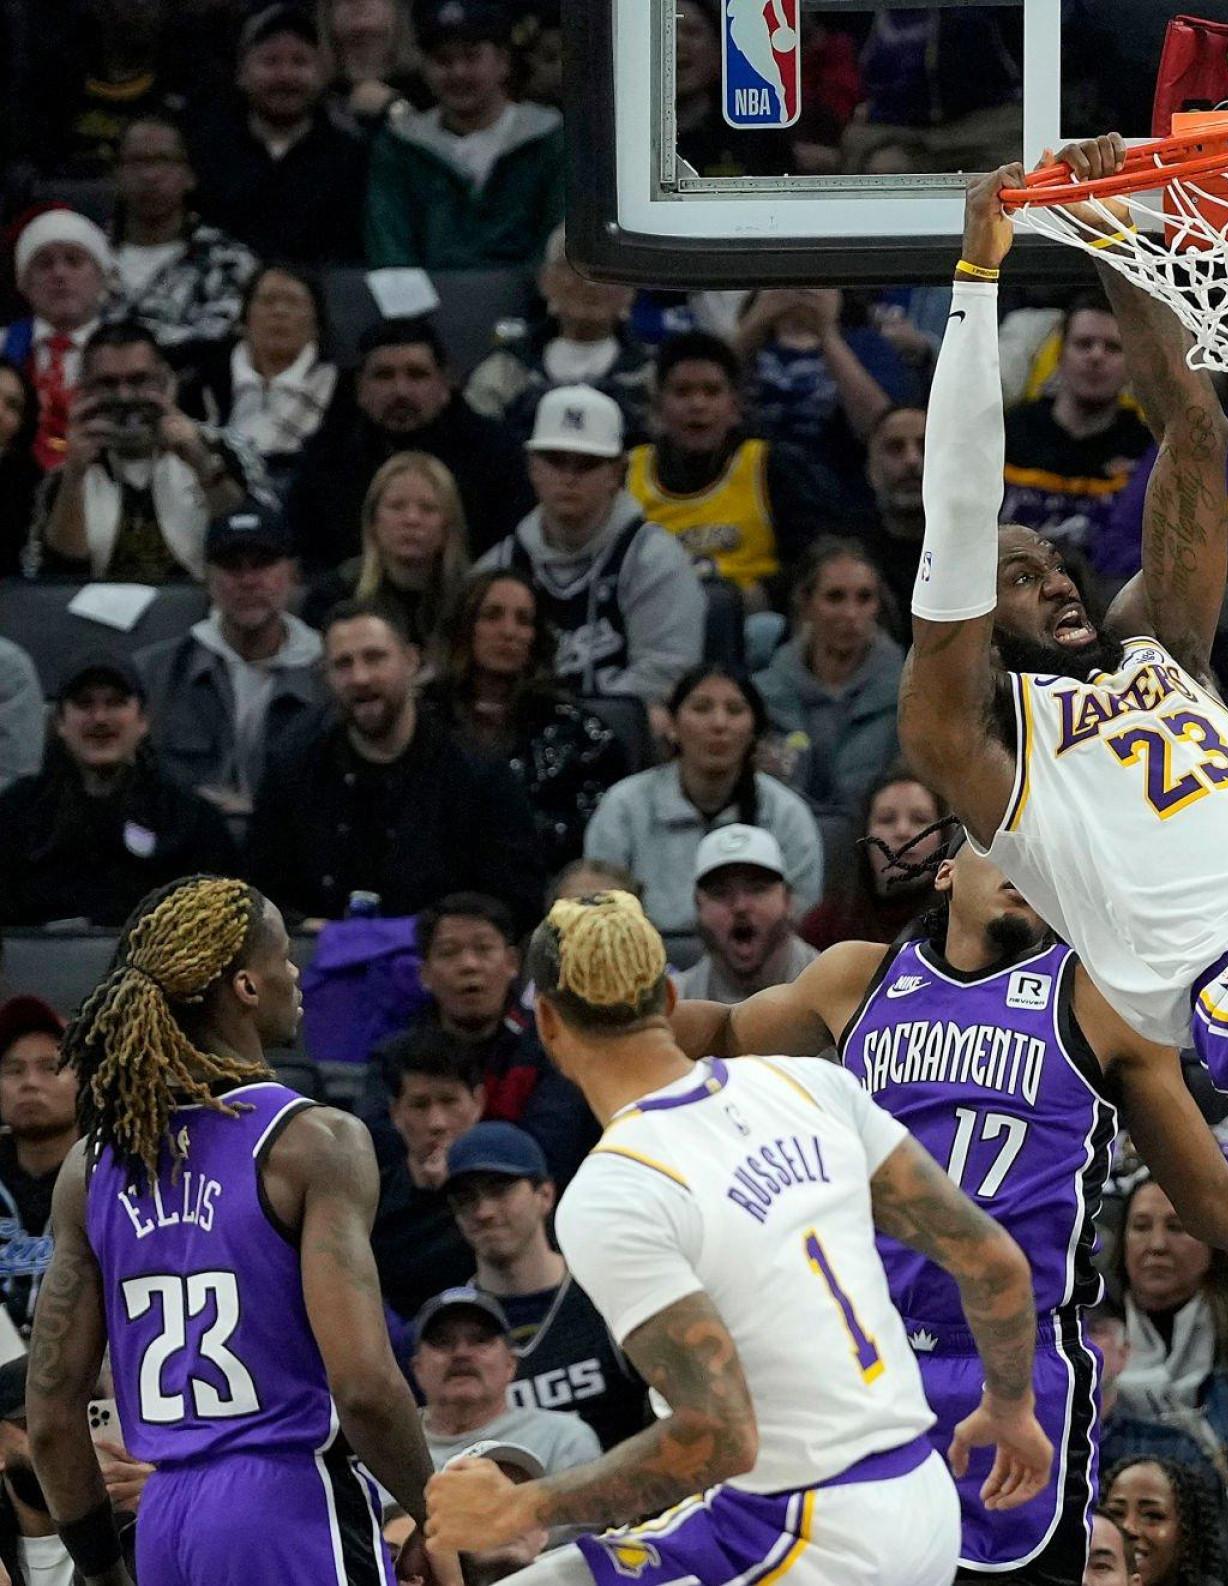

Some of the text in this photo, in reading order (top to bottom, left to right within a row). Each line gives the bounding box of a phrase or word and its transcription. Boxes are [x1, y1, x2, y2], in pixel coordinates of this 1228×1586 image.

[734, 87, 771, 116] NBA
[1051, 663, 1199, 760] LAKERS
[893, 975, 923, 991] NIKE
[1017, 976, 1043, 997] R
[861, 1020, 1047, 1108] SACRAMENTO
[727, 1134, 831, 1225] RUSSELL
[946, 1106, 1029, 1199] 17
[117, 1170, 223, 1240] ELLIS
[120, 1270, 261, 1423] 23
[803, 1226, 886, 1386] 1
